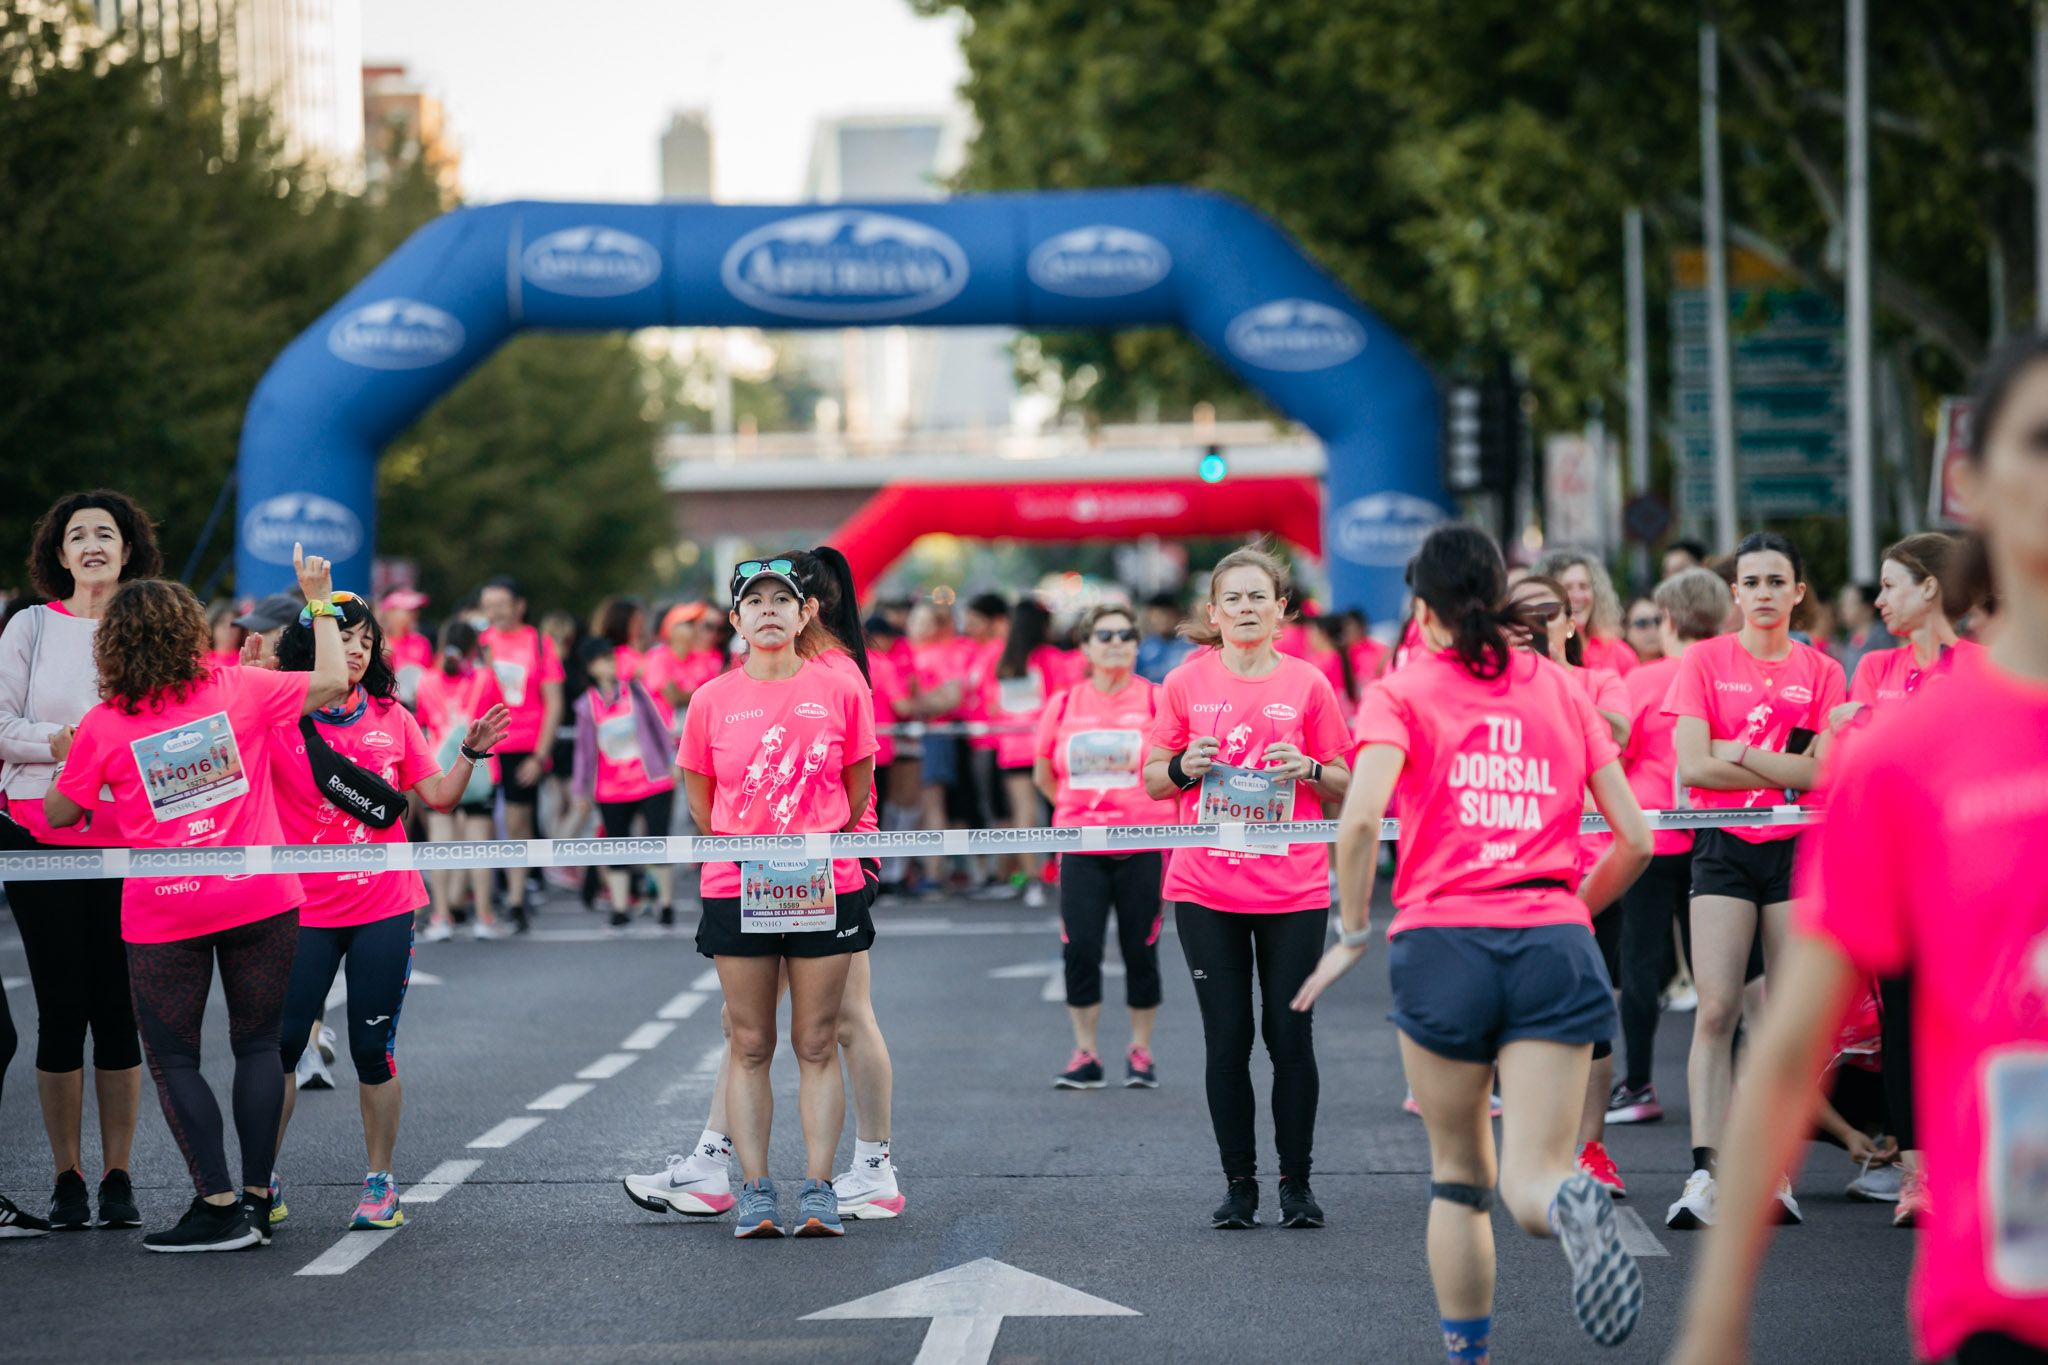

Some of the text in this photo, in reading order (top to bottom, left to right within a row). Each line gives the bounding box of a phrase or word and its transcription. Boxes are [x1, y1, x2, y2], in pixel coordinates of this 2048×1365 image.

[725, 708, 764, 724] OYSHO
[1485, 716, 1522, 753] TU
[176, 758, 212, 780] 016
[1449, 752, 1557, 795] DORSAL
[328, 774, 373, 811] Reebok
[1230, 804, 1265, 820] 016
[1460, 790, 1543, 830] SUMA
[188, 817, 216, 836] 2024
[155, 881, 200, 896] OYSHO
[772, 885, 808, 899] 016
[751, 920, 782, 928] OYSHO
